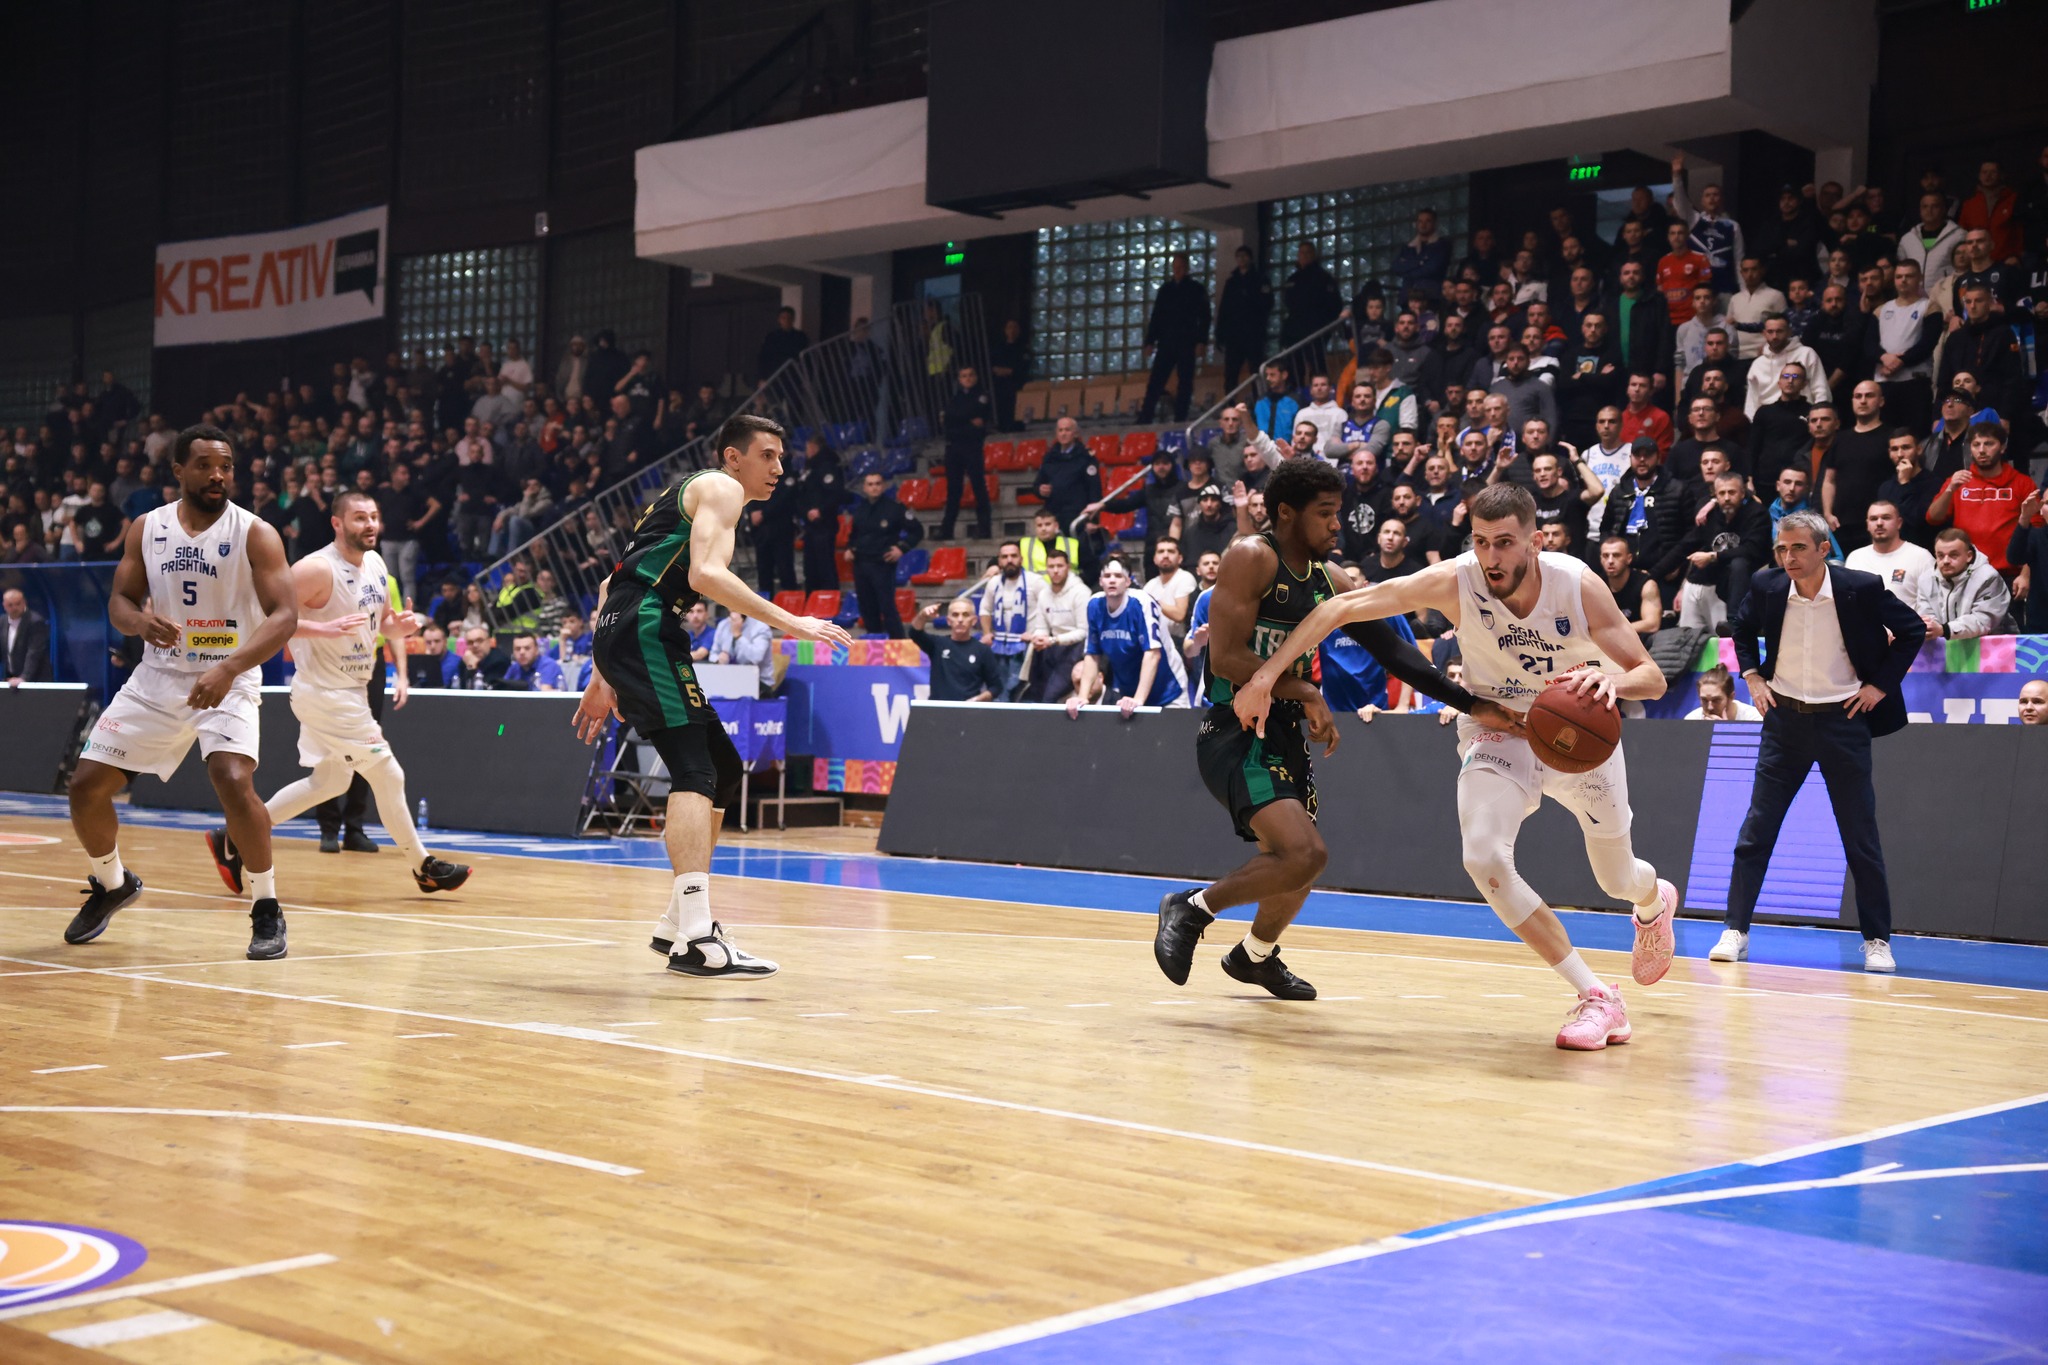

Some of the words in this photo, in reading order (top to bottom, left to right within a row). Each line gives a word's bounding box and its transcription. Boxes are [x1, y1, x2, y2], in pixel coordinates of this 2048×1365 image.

[155, 239, 335, 318] KREATIV
[175, 546, 205, 561] SIGAL
[161, 559, 218, 579] PRISHTINA
[183, 581, 197, 606] 5
[186, 619, 226, 628] KREATIV
[192, 634, 234, 646] gorenje
[1508, 623, 1545, 642] SIGAL
[1498, 634, 1566, 651] PRISHTINA
[1519, 653, 1554, 675] 27
[92, 742, 127, 758] DENTFIX
[1474, 752, 1512, 769] DENTFIX
